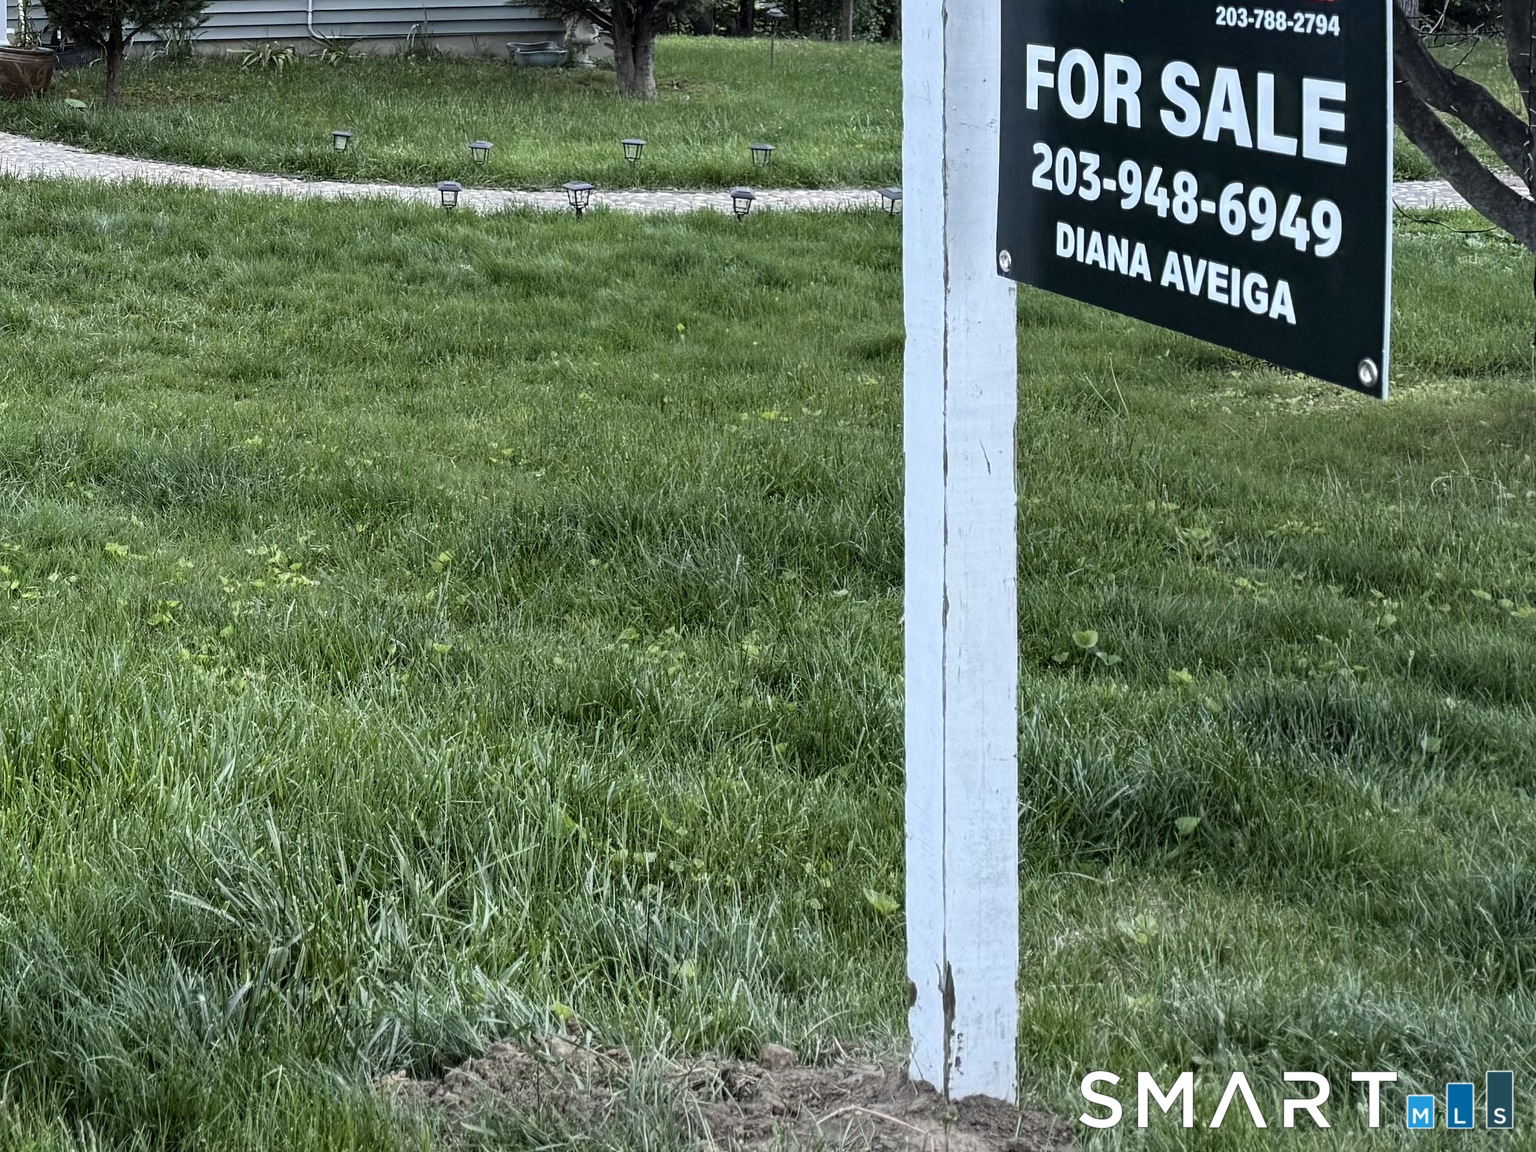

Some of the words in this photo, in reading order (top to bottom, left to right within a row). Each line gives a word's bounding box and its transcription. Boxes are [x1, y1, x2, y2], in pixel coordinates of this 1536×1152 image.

[1215, 6, 1340, 36] 203-788-2794
[1026, 44, 1142, 129] FOR
[1159, 60, 1348, 166] SALE
[1031, 142, 1342, 257] 203-948-6949
[1056, 221, 1152, 282] DIANA
[1160, 251, 1297, 325] AVEIGA
